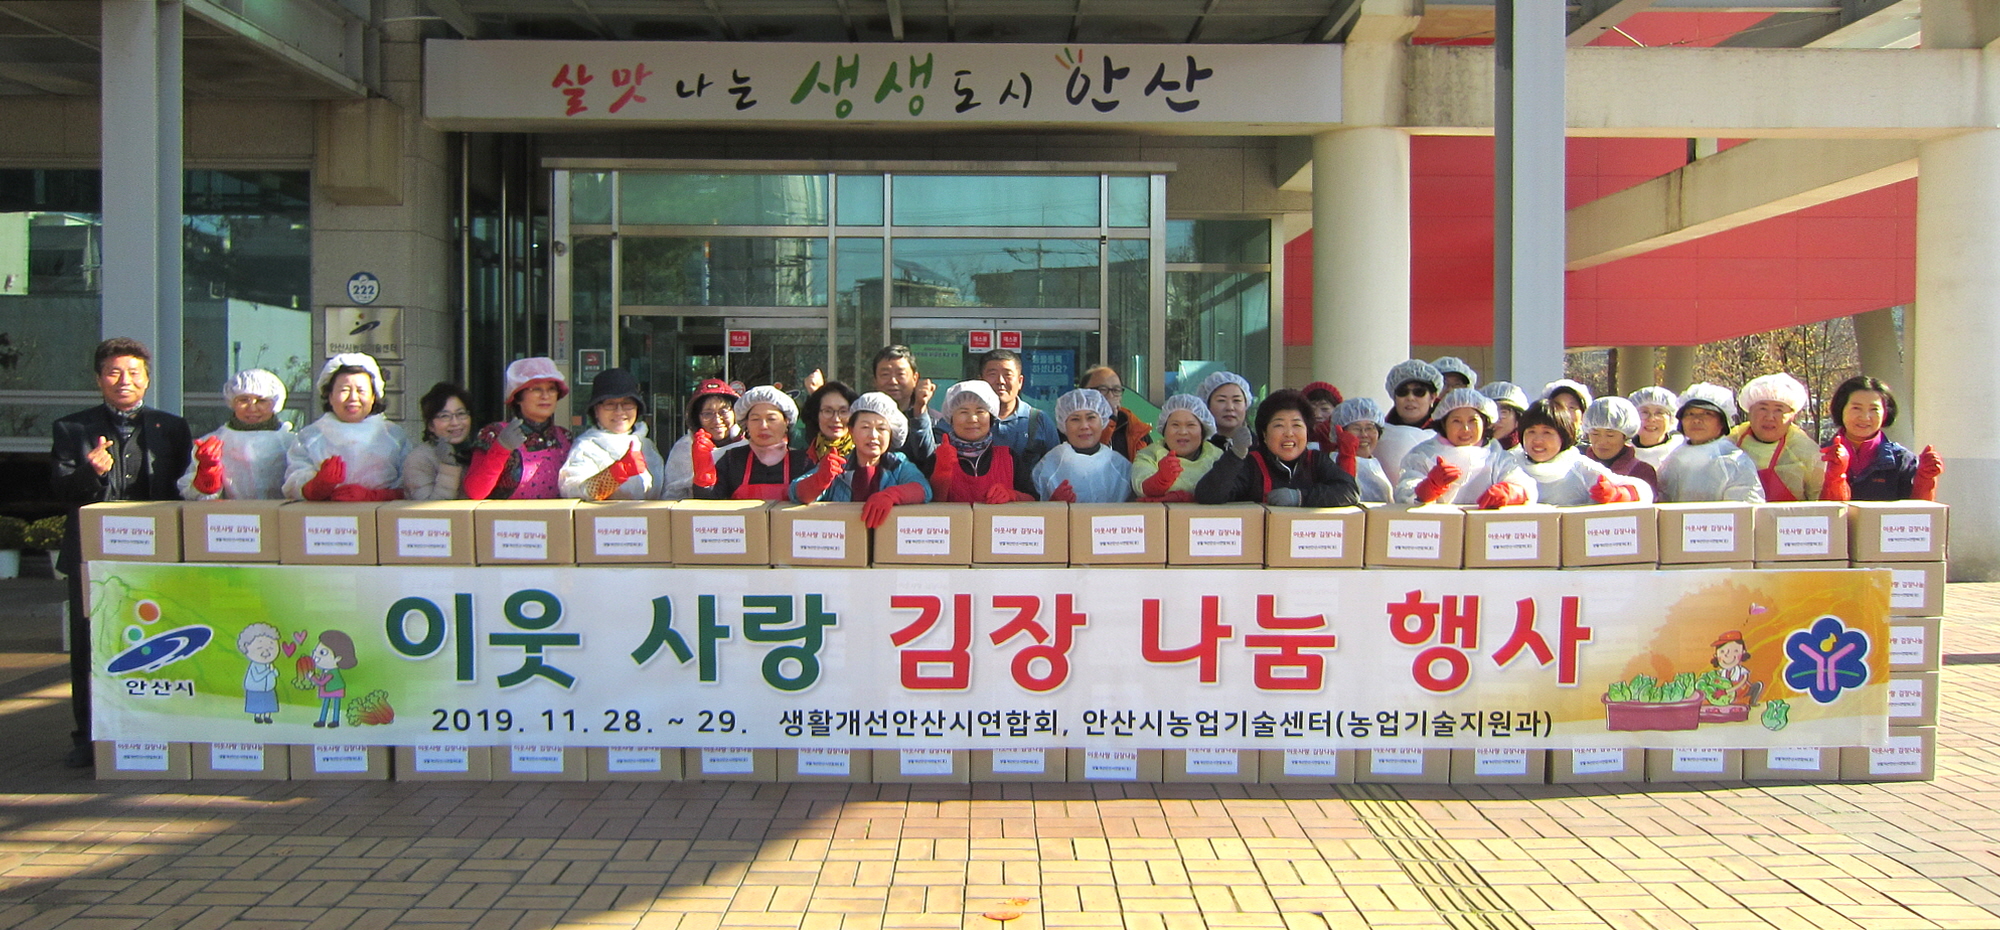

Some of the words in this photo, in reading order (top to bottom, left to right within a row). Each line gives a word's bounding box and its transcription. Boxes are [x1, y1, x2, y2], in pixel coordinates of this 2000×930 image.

[551, 62, 653, 117] 살맛
[676, 69, 758, 111] 나는
[789, 52, 934, 119] 생생
[953, 69, 1033, 114] 도시
[1065, 55, 1214, 112] 안산
[353, 284, 375, 295] 222
[385, 589, 581, 690] 이웃
[630, 594, 838, 692] 사랑
[889, 592, 1087, 692] 김장
[1141, 593, 1337, 692] 나눔
[1386, 589, 1592, 693] 행사
[125, 679, 194, 698] 안산시
[432, 709, 525, 734] 2019.
[541, 709, 590, 734] 11.
[603, 709, 654, 735] 28.
[668, 718, 685, 727] ~
[698, 710, 749, 736] 29.
[779, 710, 1069, 739] 생활개선안산시연합회,
[1082, 709, 1554, 740] 안산시농업기술센터(농업기술지원과)
